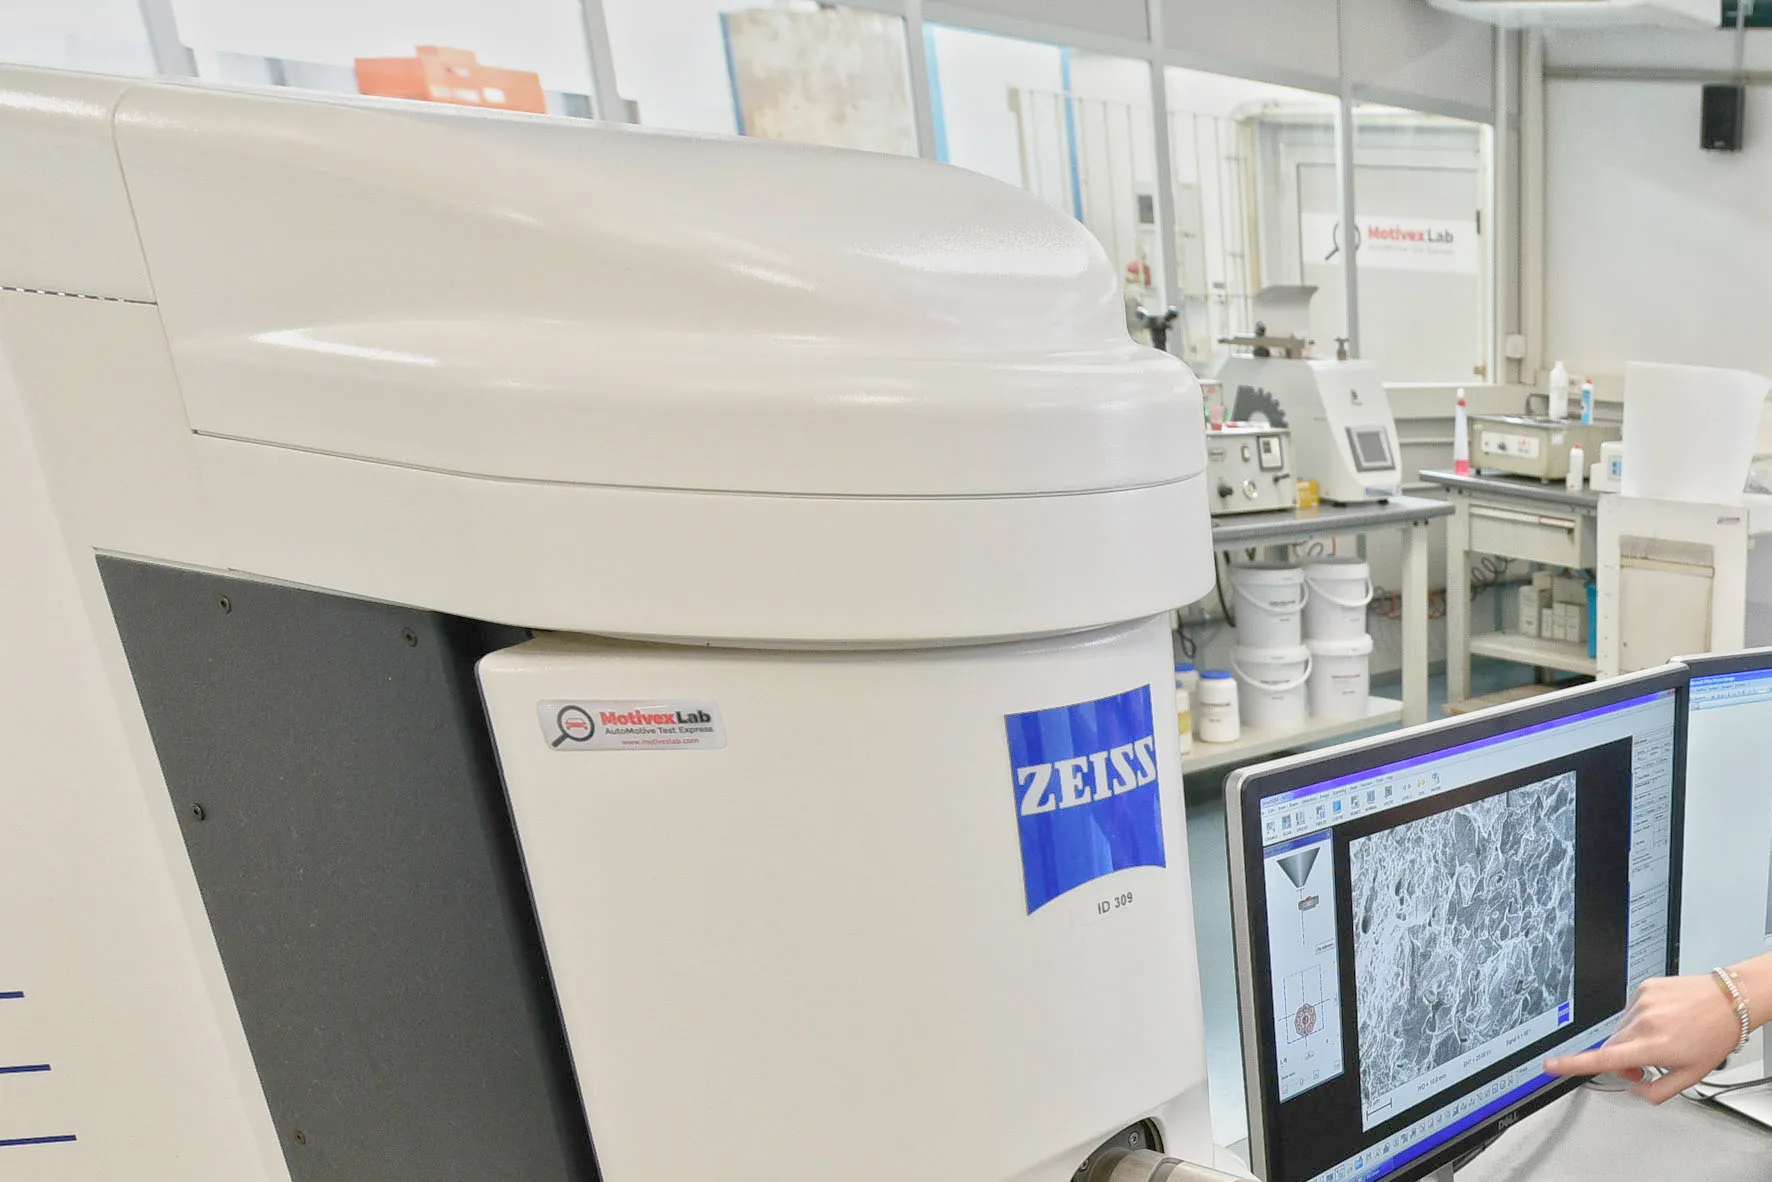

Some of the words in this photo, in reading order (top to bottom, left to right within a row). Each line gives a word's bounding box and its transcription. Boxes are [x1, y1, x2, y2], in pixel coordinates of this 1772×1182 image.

[658, 726, 676, 735] Test
[678, 725, 714, 734] Express
[1016, 736, 1157, 816] ZEISS
[1097, 900, 1111, 915] ID
[1114, 892, 1133, 909] 309
